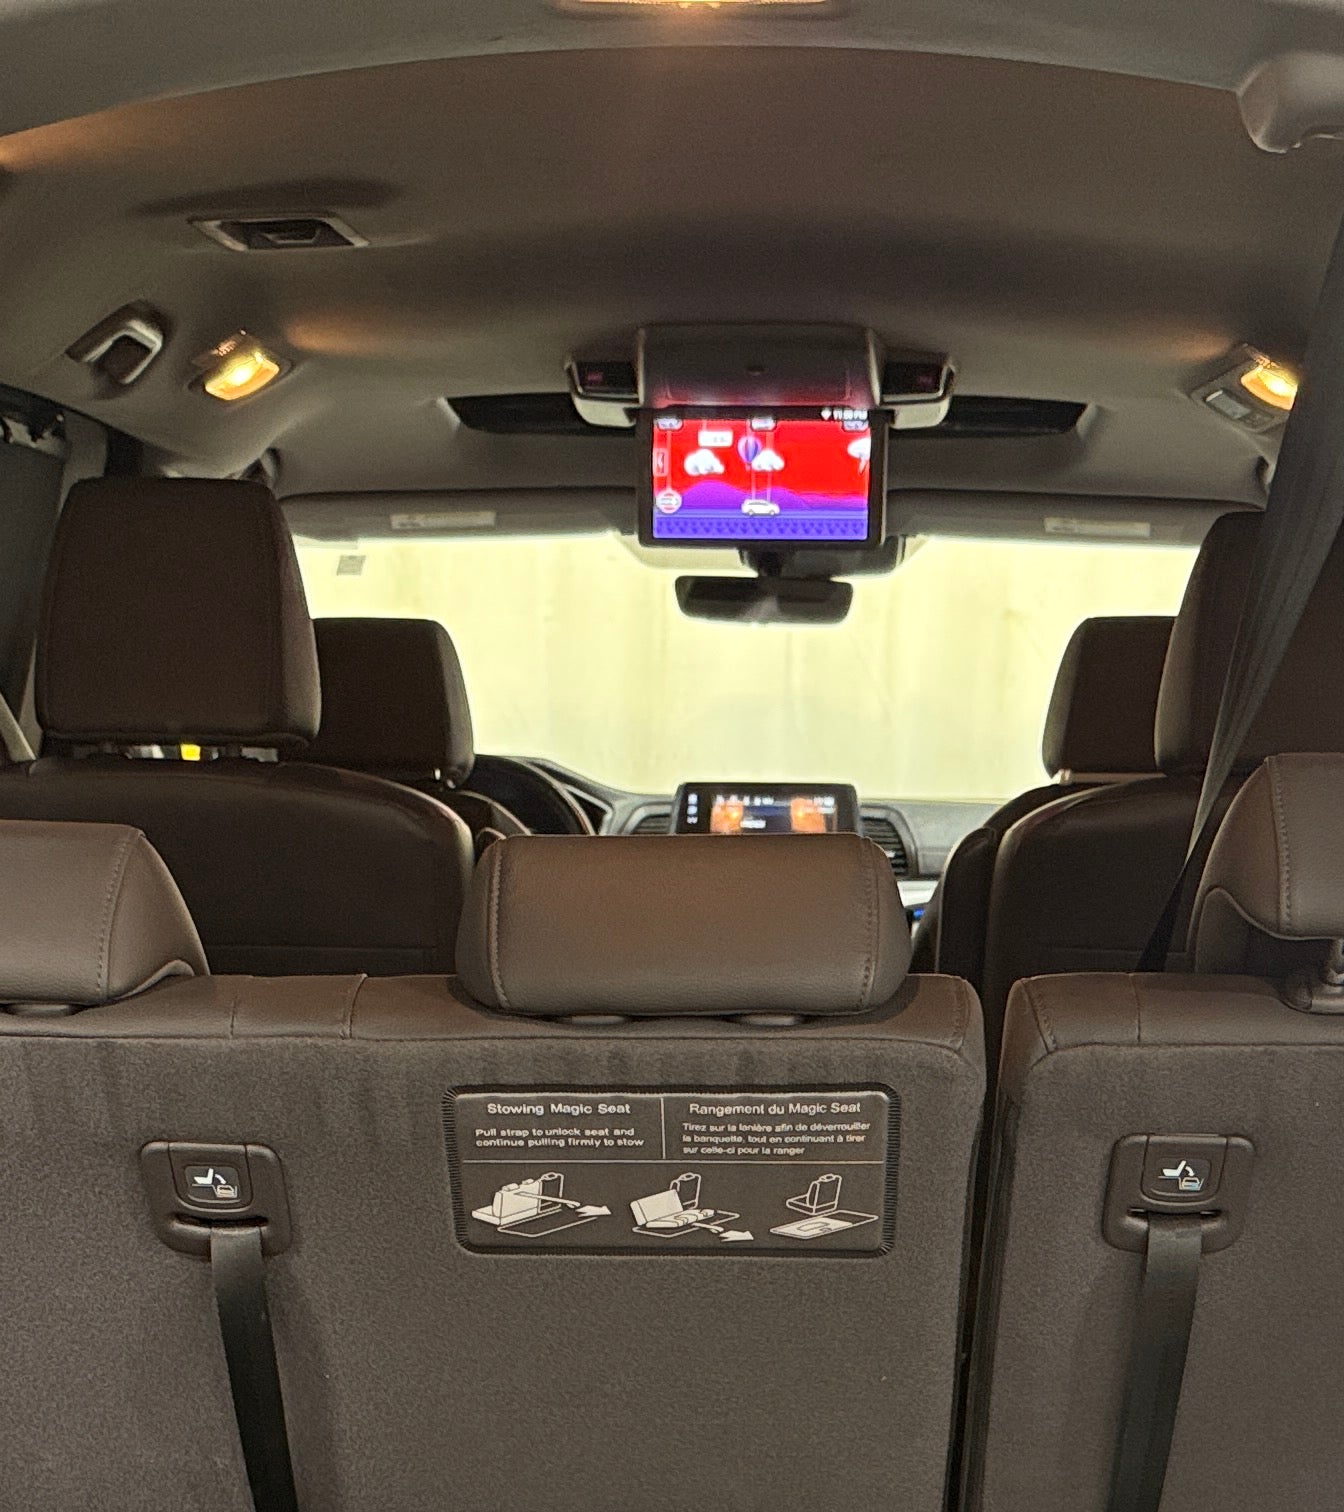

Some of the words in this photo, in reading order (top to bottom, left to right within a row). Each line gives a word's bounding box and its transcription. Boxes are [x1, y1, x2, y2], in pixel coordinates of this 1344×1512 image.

[487, 1103, 544, 1116] Stowing
[550, 1103, 592, 1116] Magic
[597, 1103, 630, 1114] Seat
[689, 1103, 765, 1117] Rangement
[768, 1103, 785, 1114] du
[788, 1102, 828, 1116] Magic
[830, 1102, 861, 1113] Seat
[475, 1128, 496, 1137] Pull
[500, 1128, 529, 1137] strap
[532, 1128, 543, 1136] to
[545, 1127, 581, 1136] unlock
[584, 1127, 609, 1136] seat
[613, 1127, 635, 1136] and
[682, 1122, 706, 1132] Tirez
[727, 1122, 736, 1132] la
[739, 1122, 772, 1132] lanière
[774, 1123, 793, 1132] afin
[795, 1122, 808, 1131] de
[476, 1138, 524, 1147] continue
[527, 1138, 565, 1148] pulling
[567, 1138, 601, 1148] firmly
[603, 1138, 614, 1147] to
[617, 1138, 644, 1147] stow
[682, 1134, 691, 1142] la
[747, 1134, 767, 1143] tout
[784, 1134, 835, 1143] continuant
[846, 1134, 866, 1143] tirer
[737, 1147, 759, 1156] pour
[761, 1146, 771, 1155] la
[773, 1147, 805, 1156] ranger
